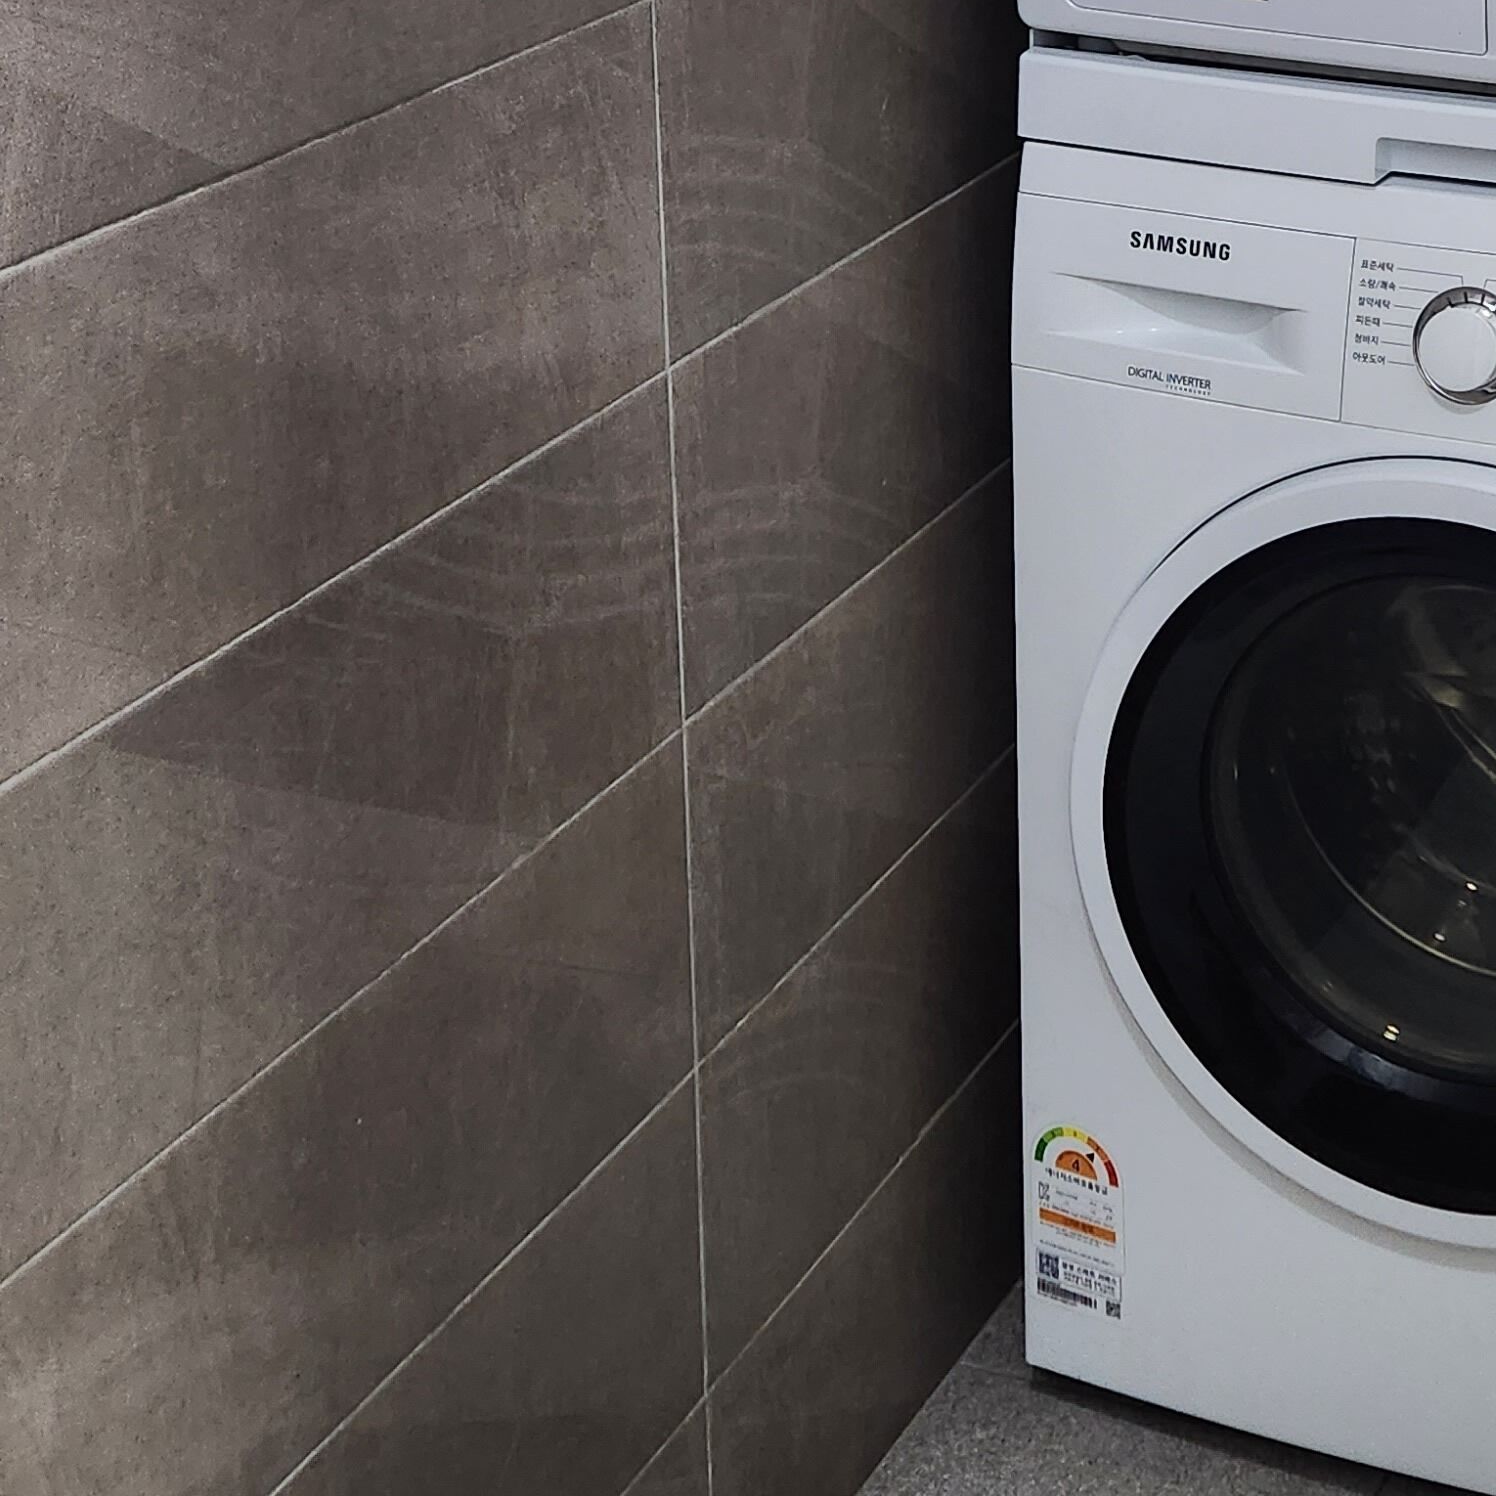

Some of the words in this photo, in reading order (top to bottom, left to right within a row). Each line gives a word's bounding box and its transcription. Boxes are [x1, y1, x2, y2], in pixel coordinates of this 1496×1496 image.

[1130, 230, 1232, 261] SAMSUNG
[1361, 259, 1394, 272] 표준세탁
[1354, 332, 1379, 345] 청바지
[1352, 351, 1386, 365] 아웃도어
[1127, 366, 1164, 382] DIGITAL
[1166, 373, 1211, 390] INVERTER
[1072, 1159, 1080, 1172] 4
